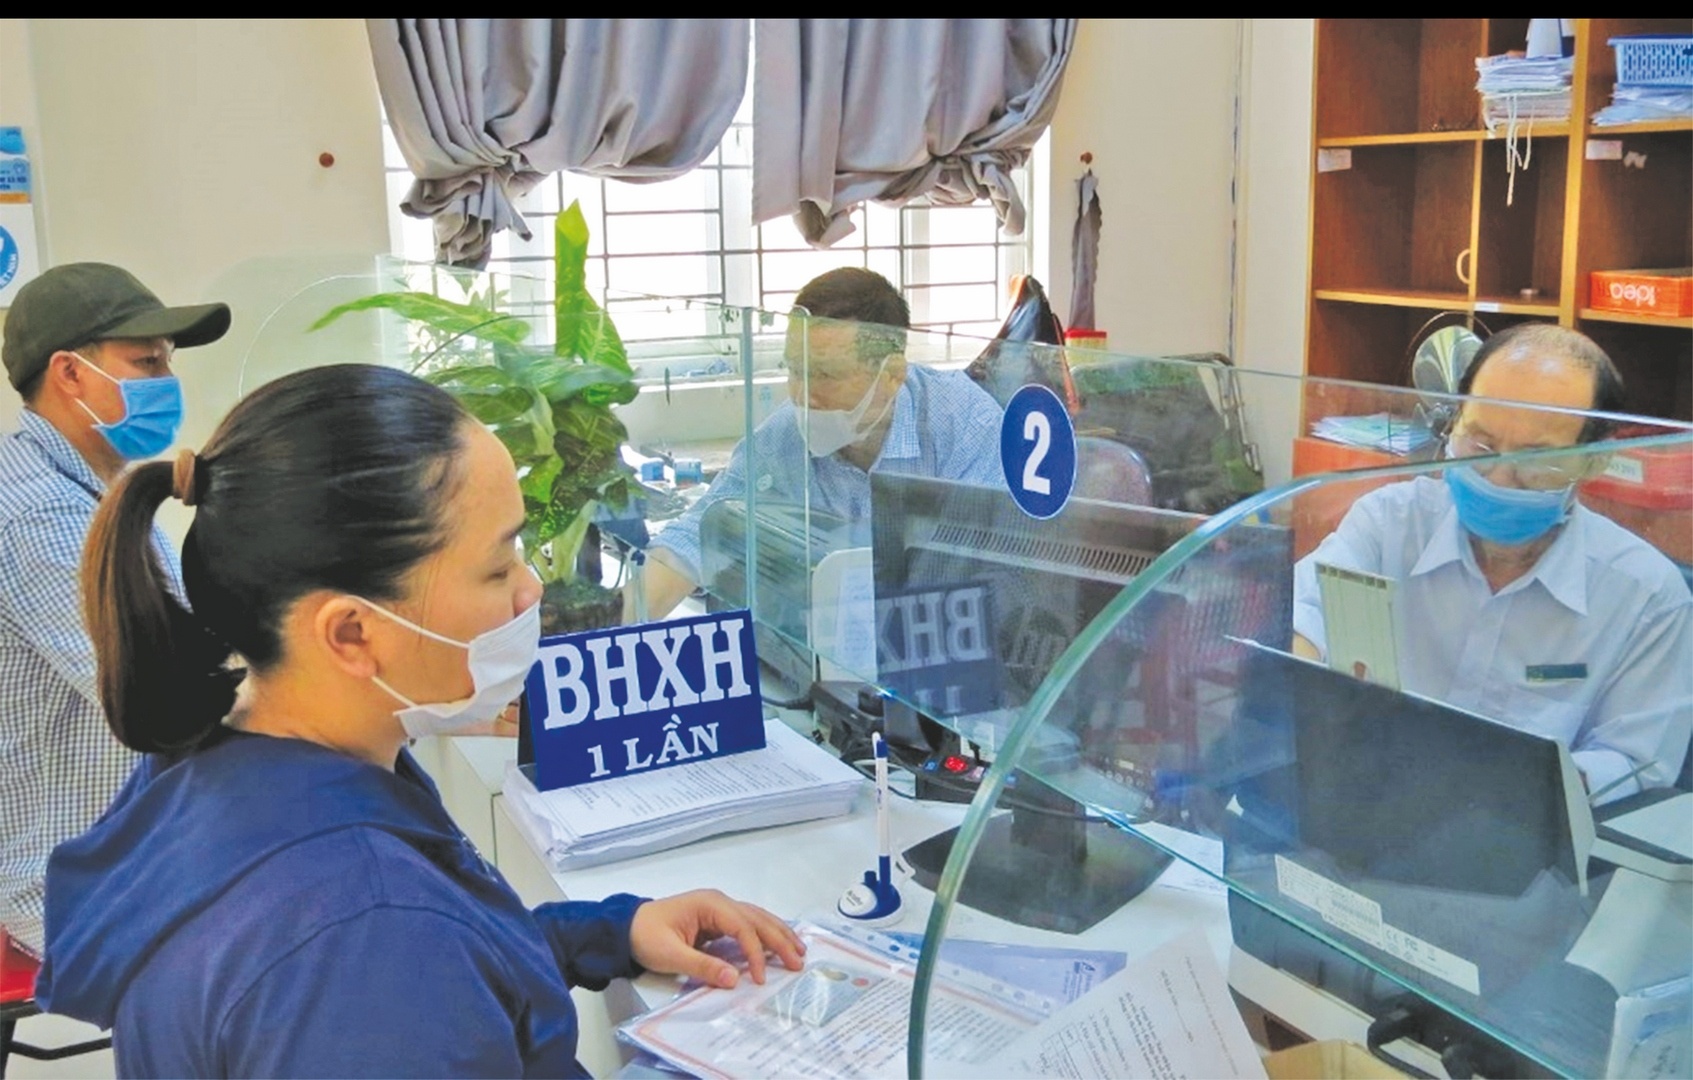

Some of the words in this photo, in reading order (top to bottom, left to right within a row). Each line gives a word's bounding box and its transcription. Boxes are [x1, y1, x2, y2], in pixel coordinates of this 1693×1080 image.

[1022, 410, 1051, 496] 2
[538, 618, 752, 731] BHXH
[586, 744, 611, 778] 1
[622, 713, 720, 771] LẦN
